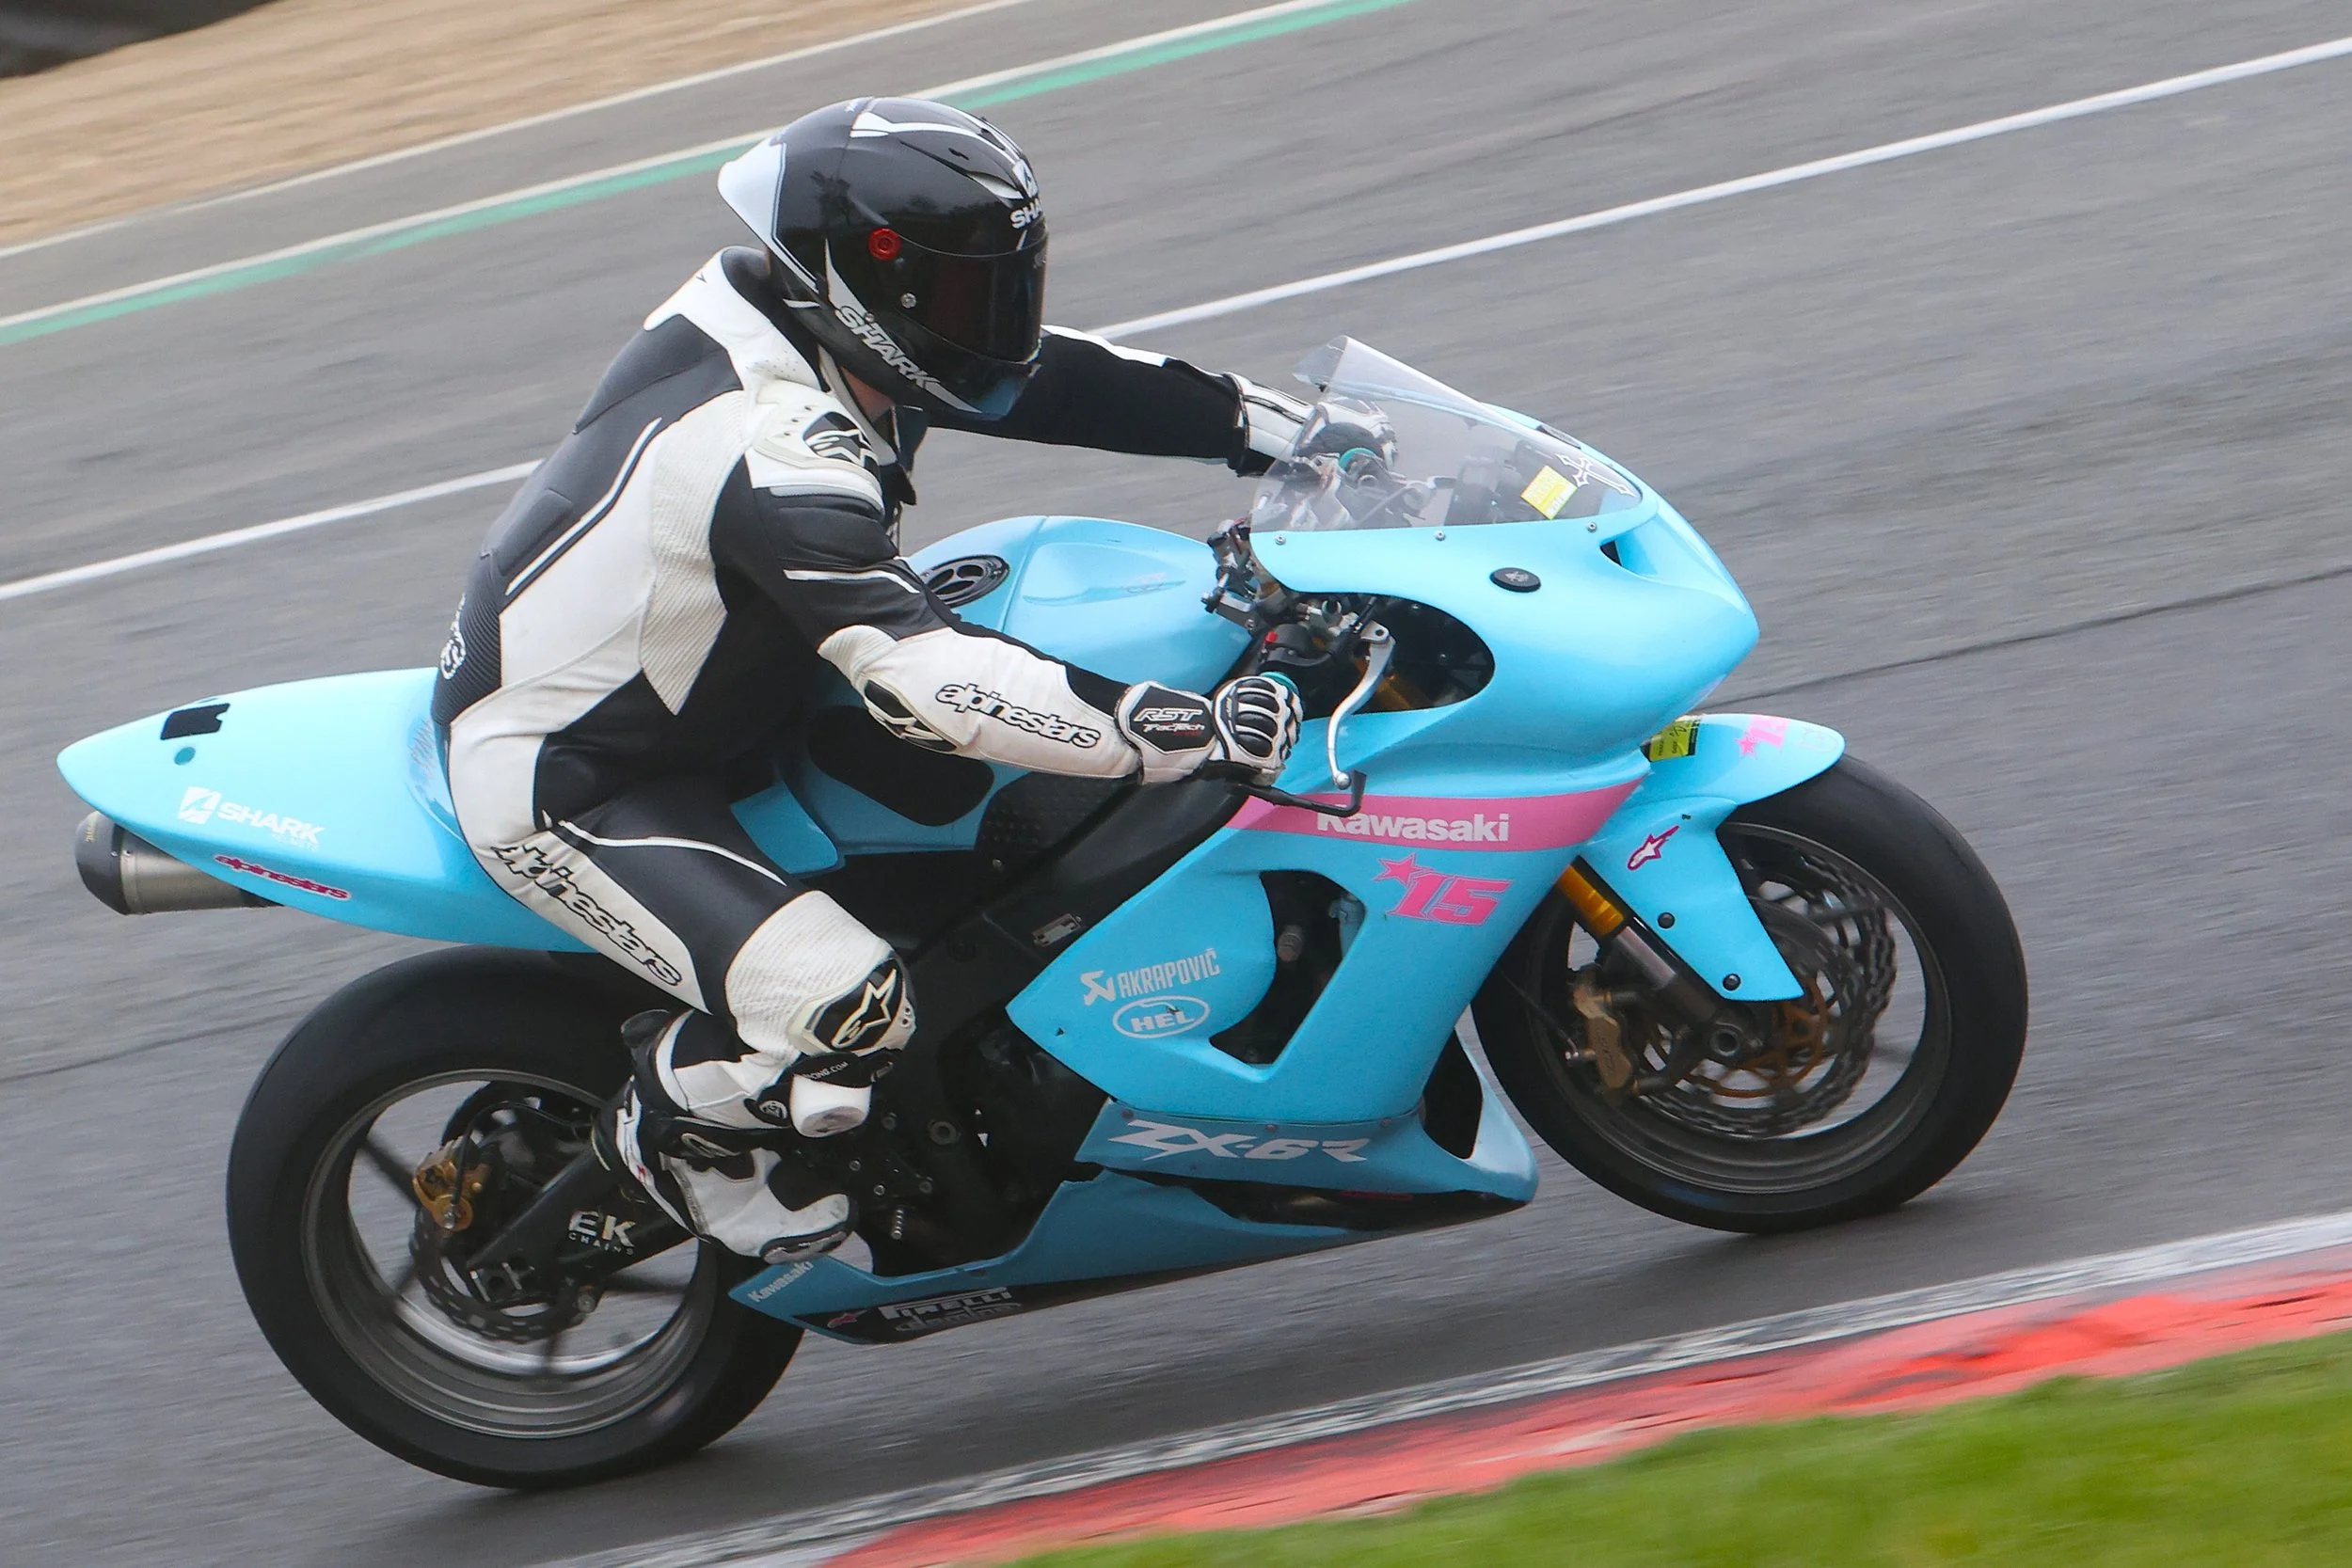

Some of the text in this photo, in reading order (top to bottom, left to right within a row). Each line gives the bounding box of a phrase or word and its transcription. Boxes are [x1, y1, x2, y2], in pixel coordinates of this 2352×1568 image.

[834, 306, 941, 389] SHARK
[935, 682, 1102, 749] alpinestars
[1134, 707, 1203, 722] RST
[217, 802, 326, 844] SHARK
[1317, 804, 1509, 842] Kawasaki
[215, 854, 351, 901] alpinestars
[1386, 870, 1515, 926] 15
[1131, 1010, 1196, 1033] HEL
[1108, 1119, 1370, 1163] ZX-6R
[568, 1210, 637, 1248] EK
[568, 1231, 634, 1256] CHAINS
[747, 1260, 815, 1303] Kawasaki
[877, 1286, 1012, 1320] PIRELLI
